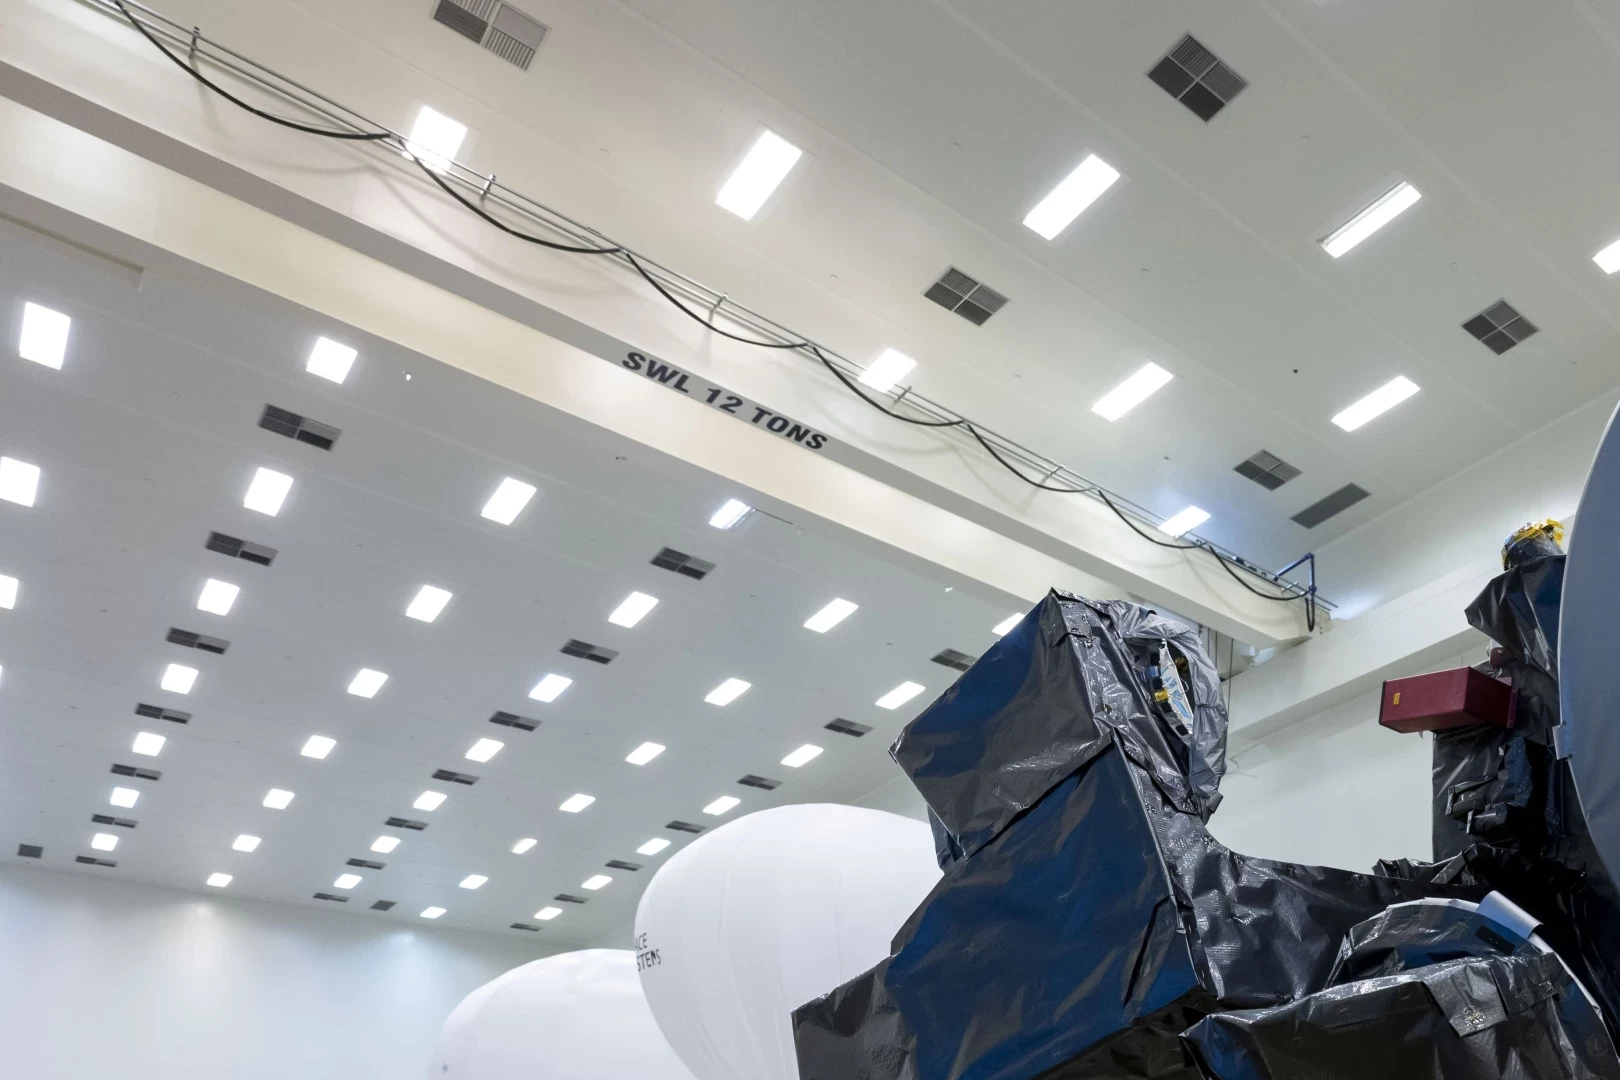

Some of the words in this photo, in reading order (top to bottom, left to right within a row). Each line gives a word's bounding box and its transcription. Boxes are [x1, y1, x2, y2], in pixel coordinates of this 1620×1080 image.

[621, 351, 689, 393] SWL
[705, 387, 744, 414] 12
[750, 406, 828, 450] TONS
